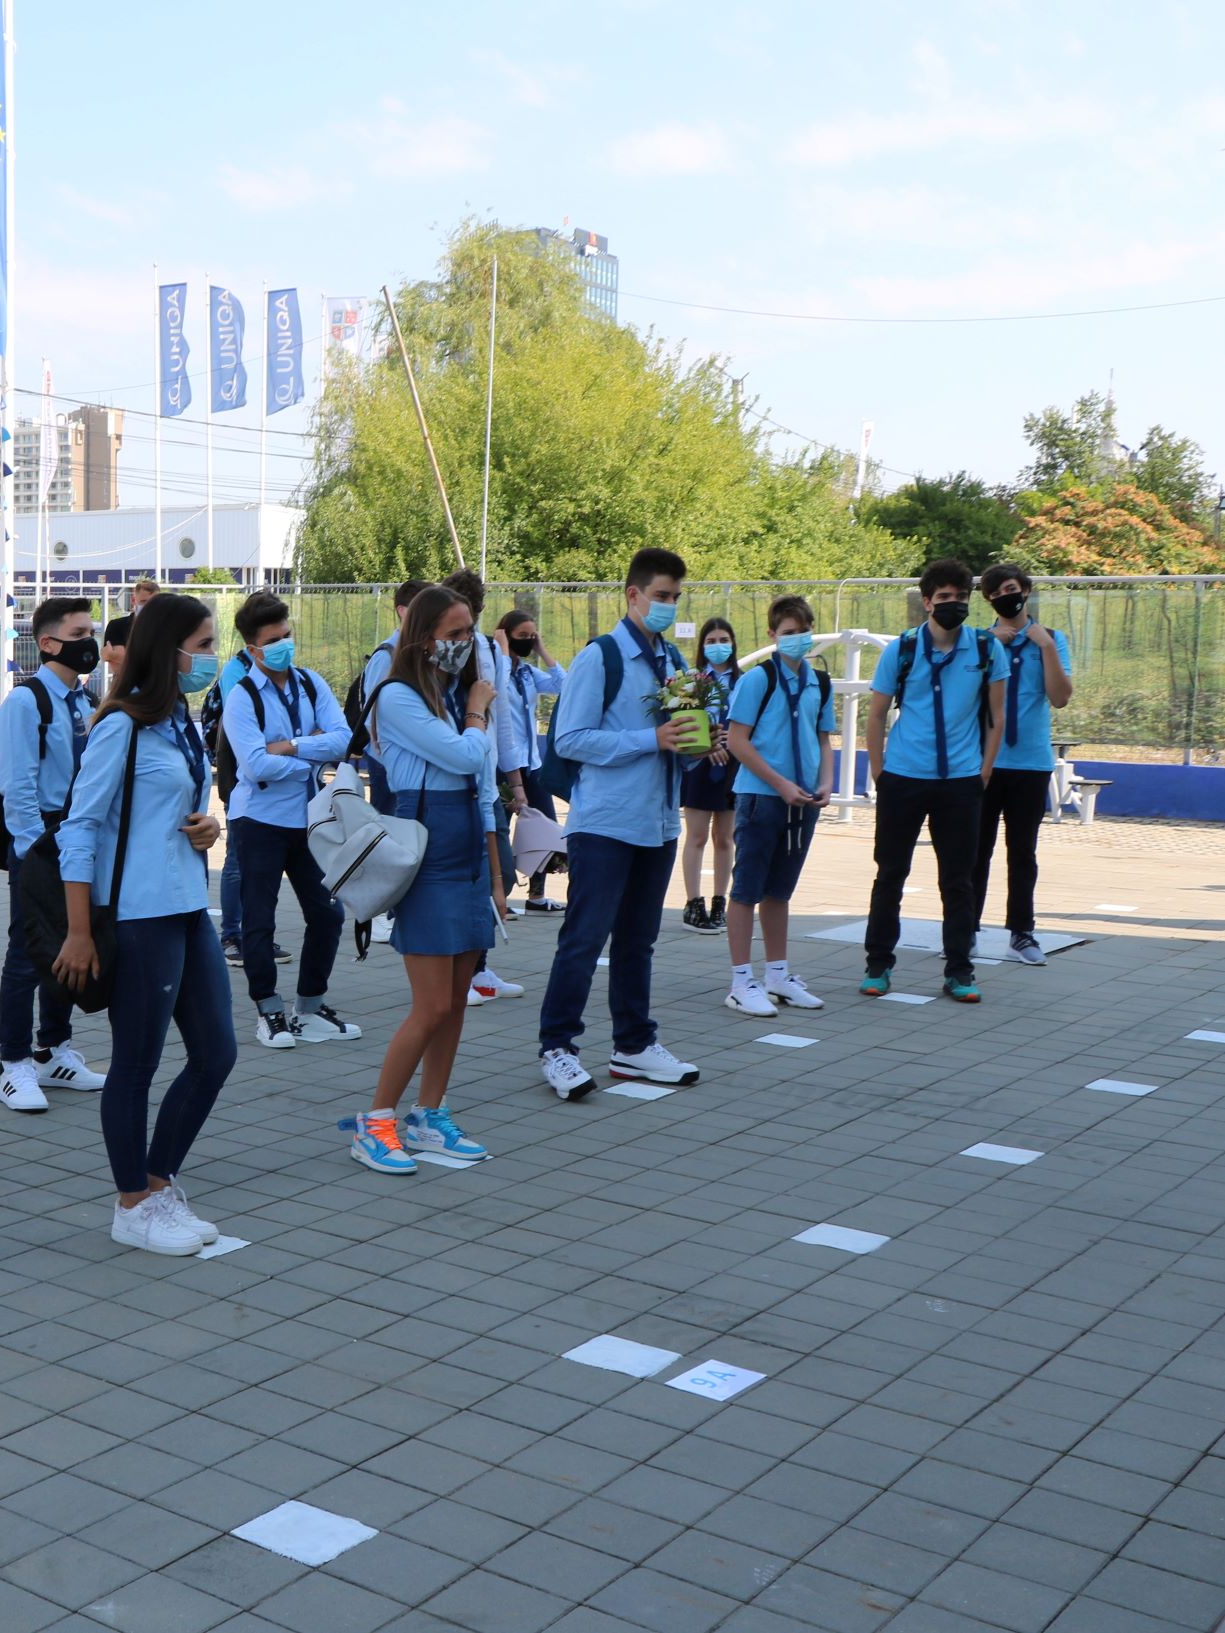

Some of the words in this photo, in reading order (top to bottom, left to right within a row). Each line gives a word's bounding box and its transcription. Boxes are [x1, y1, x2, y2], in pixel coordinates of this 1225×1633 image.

[167, 289, 183, 373] UNIQA
[217, 289, 237, 369] UNIQA
[275, 293, 294, 373] UNIQA
